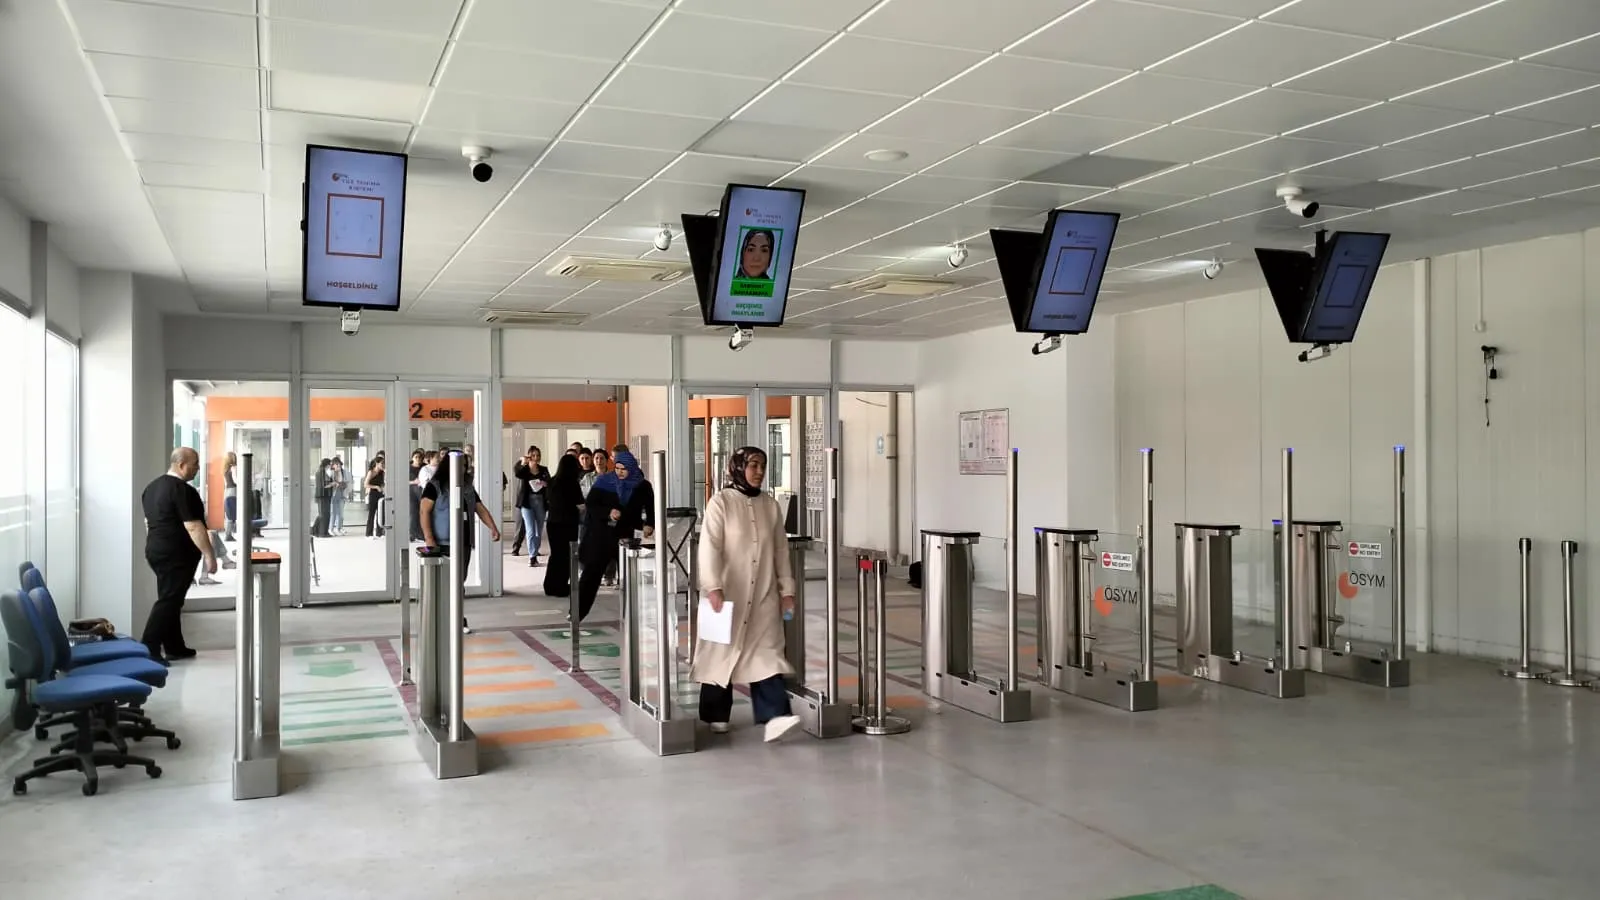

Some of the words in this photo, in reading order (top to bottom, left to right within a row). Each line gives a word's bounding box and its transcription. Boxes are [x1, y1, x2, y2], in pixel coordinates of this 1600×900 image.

[430, 408, 462, 421] GİRİŞ
[1350, 570, 1385, 588] ÖSYM
[1104, 584, 1138, 604] ÖSYM
